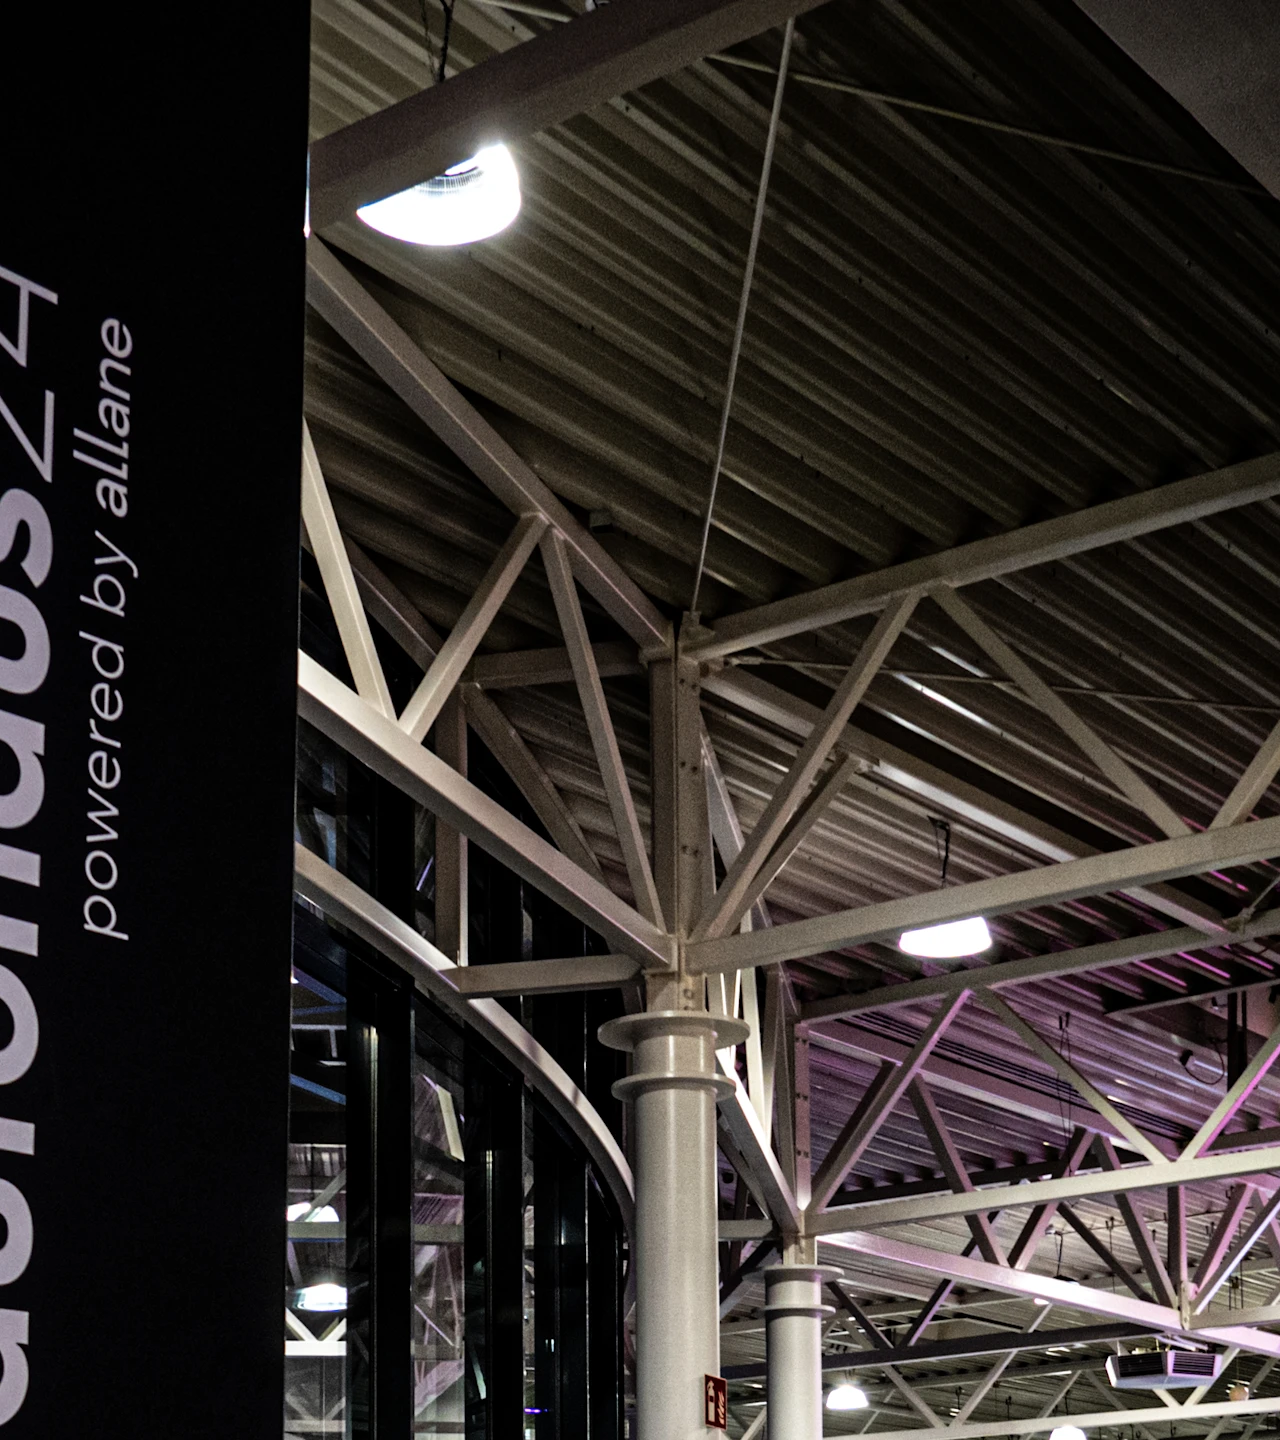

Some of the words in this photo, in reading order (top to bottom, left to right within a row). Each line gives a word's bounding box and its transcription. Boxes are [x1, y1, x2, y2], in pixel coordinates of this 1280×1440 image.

[72, 317, 133, 518] allane
[78, 528, 139, 618] by
[78, 630, 129, 941] powered
